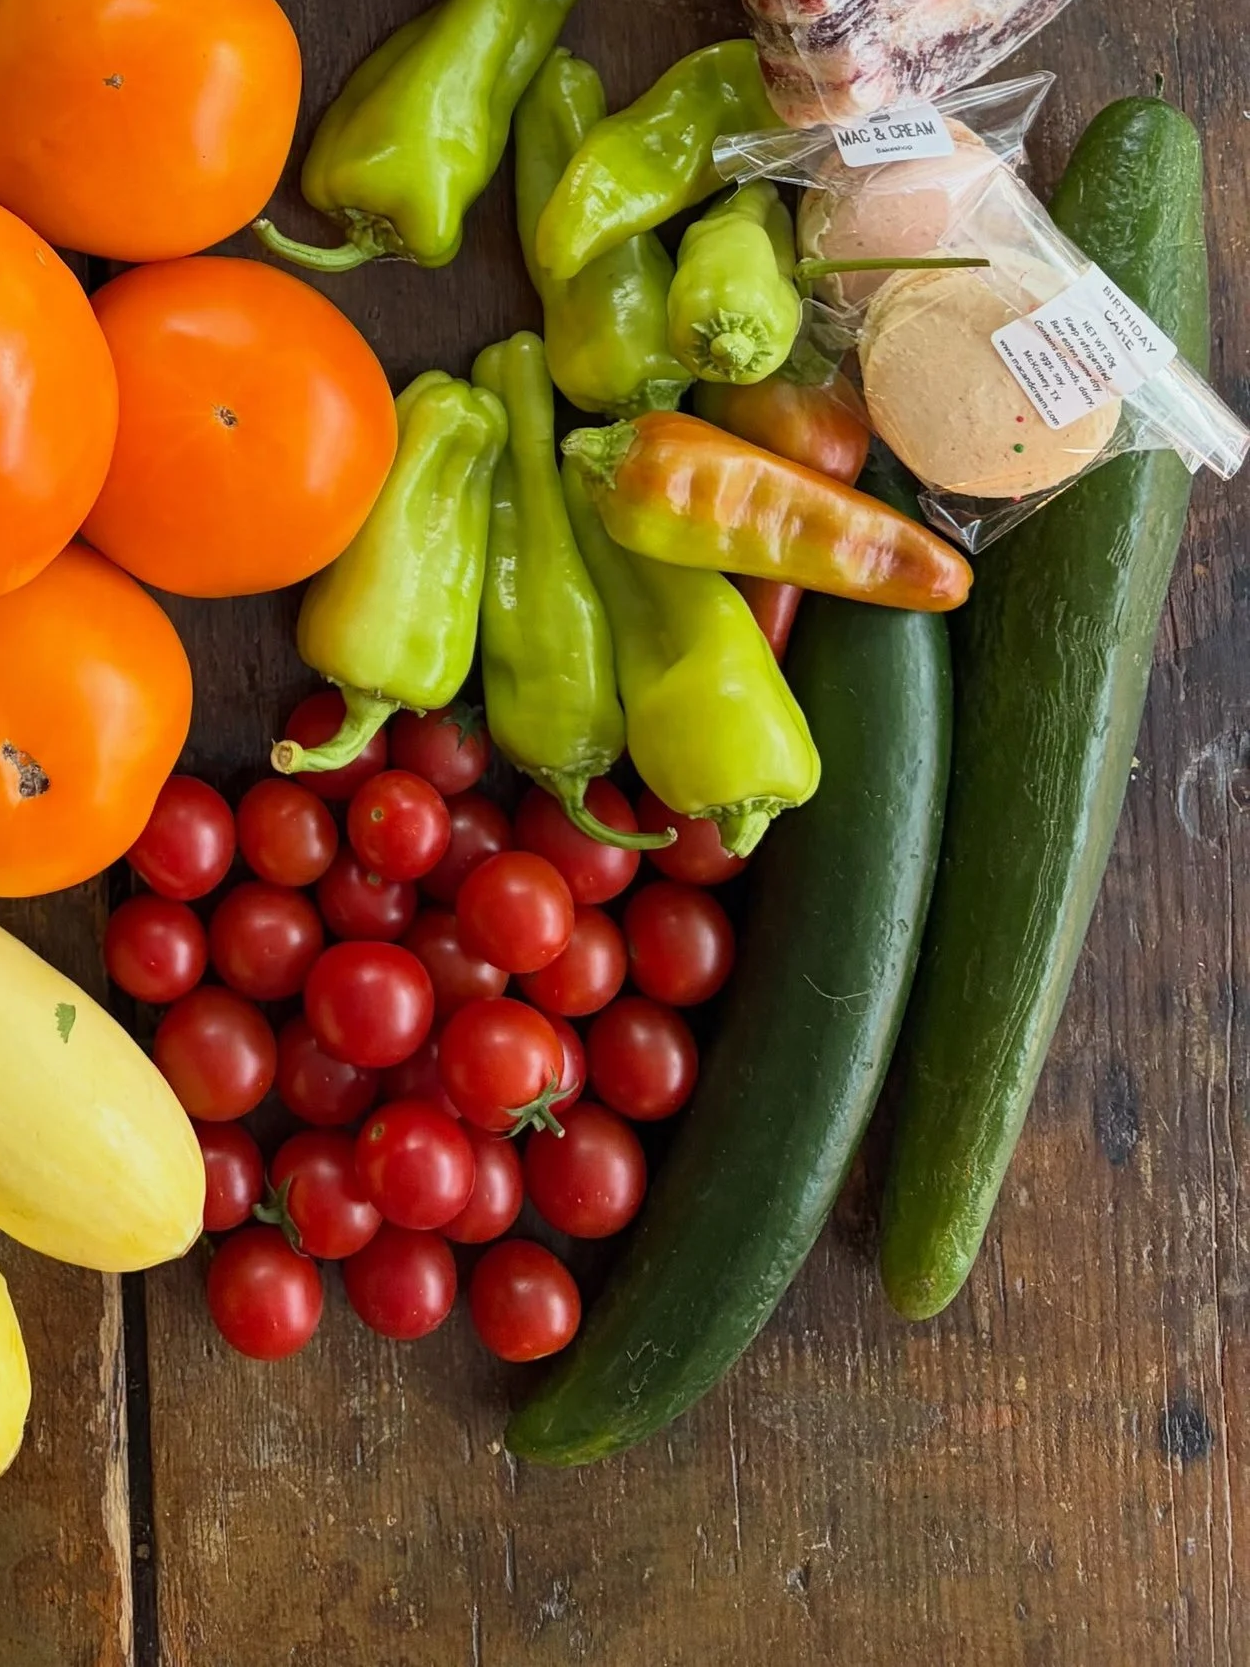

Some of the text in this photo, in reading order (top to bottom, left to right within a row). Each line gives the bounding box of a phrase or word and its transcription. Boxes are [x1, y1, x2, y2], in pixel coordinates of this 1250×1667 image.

[837, 120, 936, 147] MAC & CREAM
[1063, 316, 1080, 337] Keep
[1102, 281, 1158, 353] BIRTHDAY
[1103, 309, 1135, 351] CAKE
[1033, 320, 1059, 352] Contains
[1049, 319, 1066, 337] Best
[1061, 337, 1079, 359] eaten
[1076, 359, 1093, 378] same
[1081, 320, 1117, 370] NET WT 20g
[1049, 389, 1062, 402] TX
